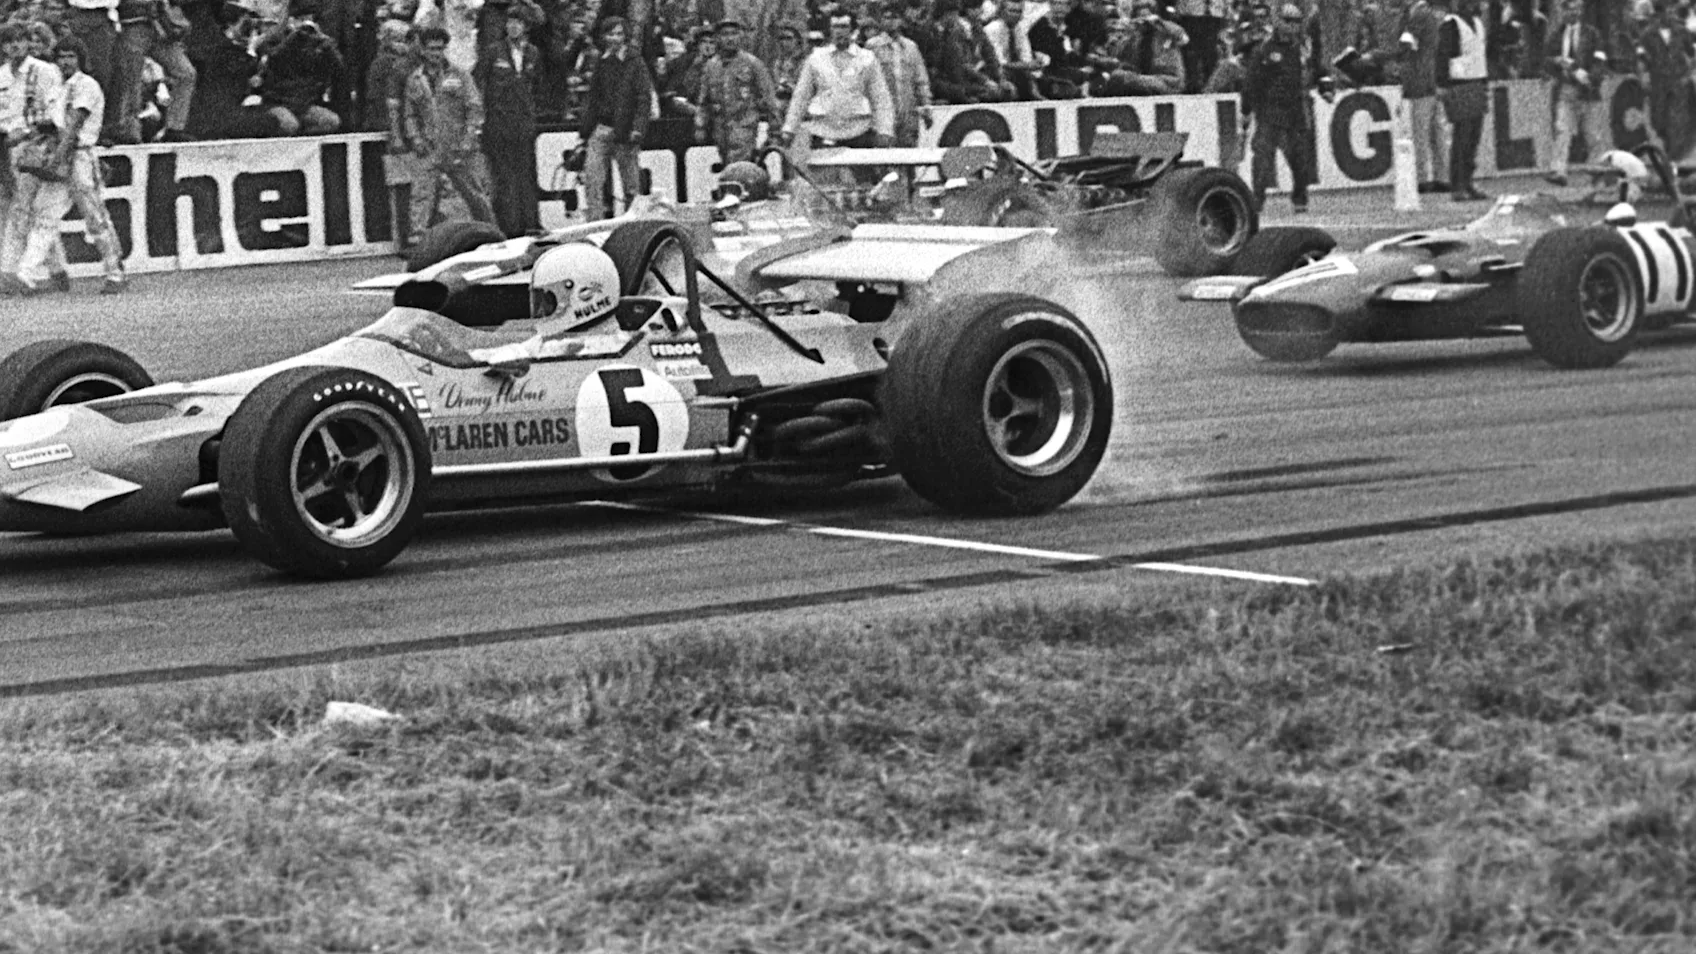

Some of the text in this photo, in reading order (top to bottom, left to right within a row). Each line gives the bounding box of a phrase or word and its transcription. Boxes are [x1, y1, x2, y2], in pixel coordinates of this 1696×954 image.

[1628, 227, 1689, 305] 11
[574, 296, 611, 319] HULME
[515, 418, 569, 447] CARS
[598, 368, 660, 480] 5
